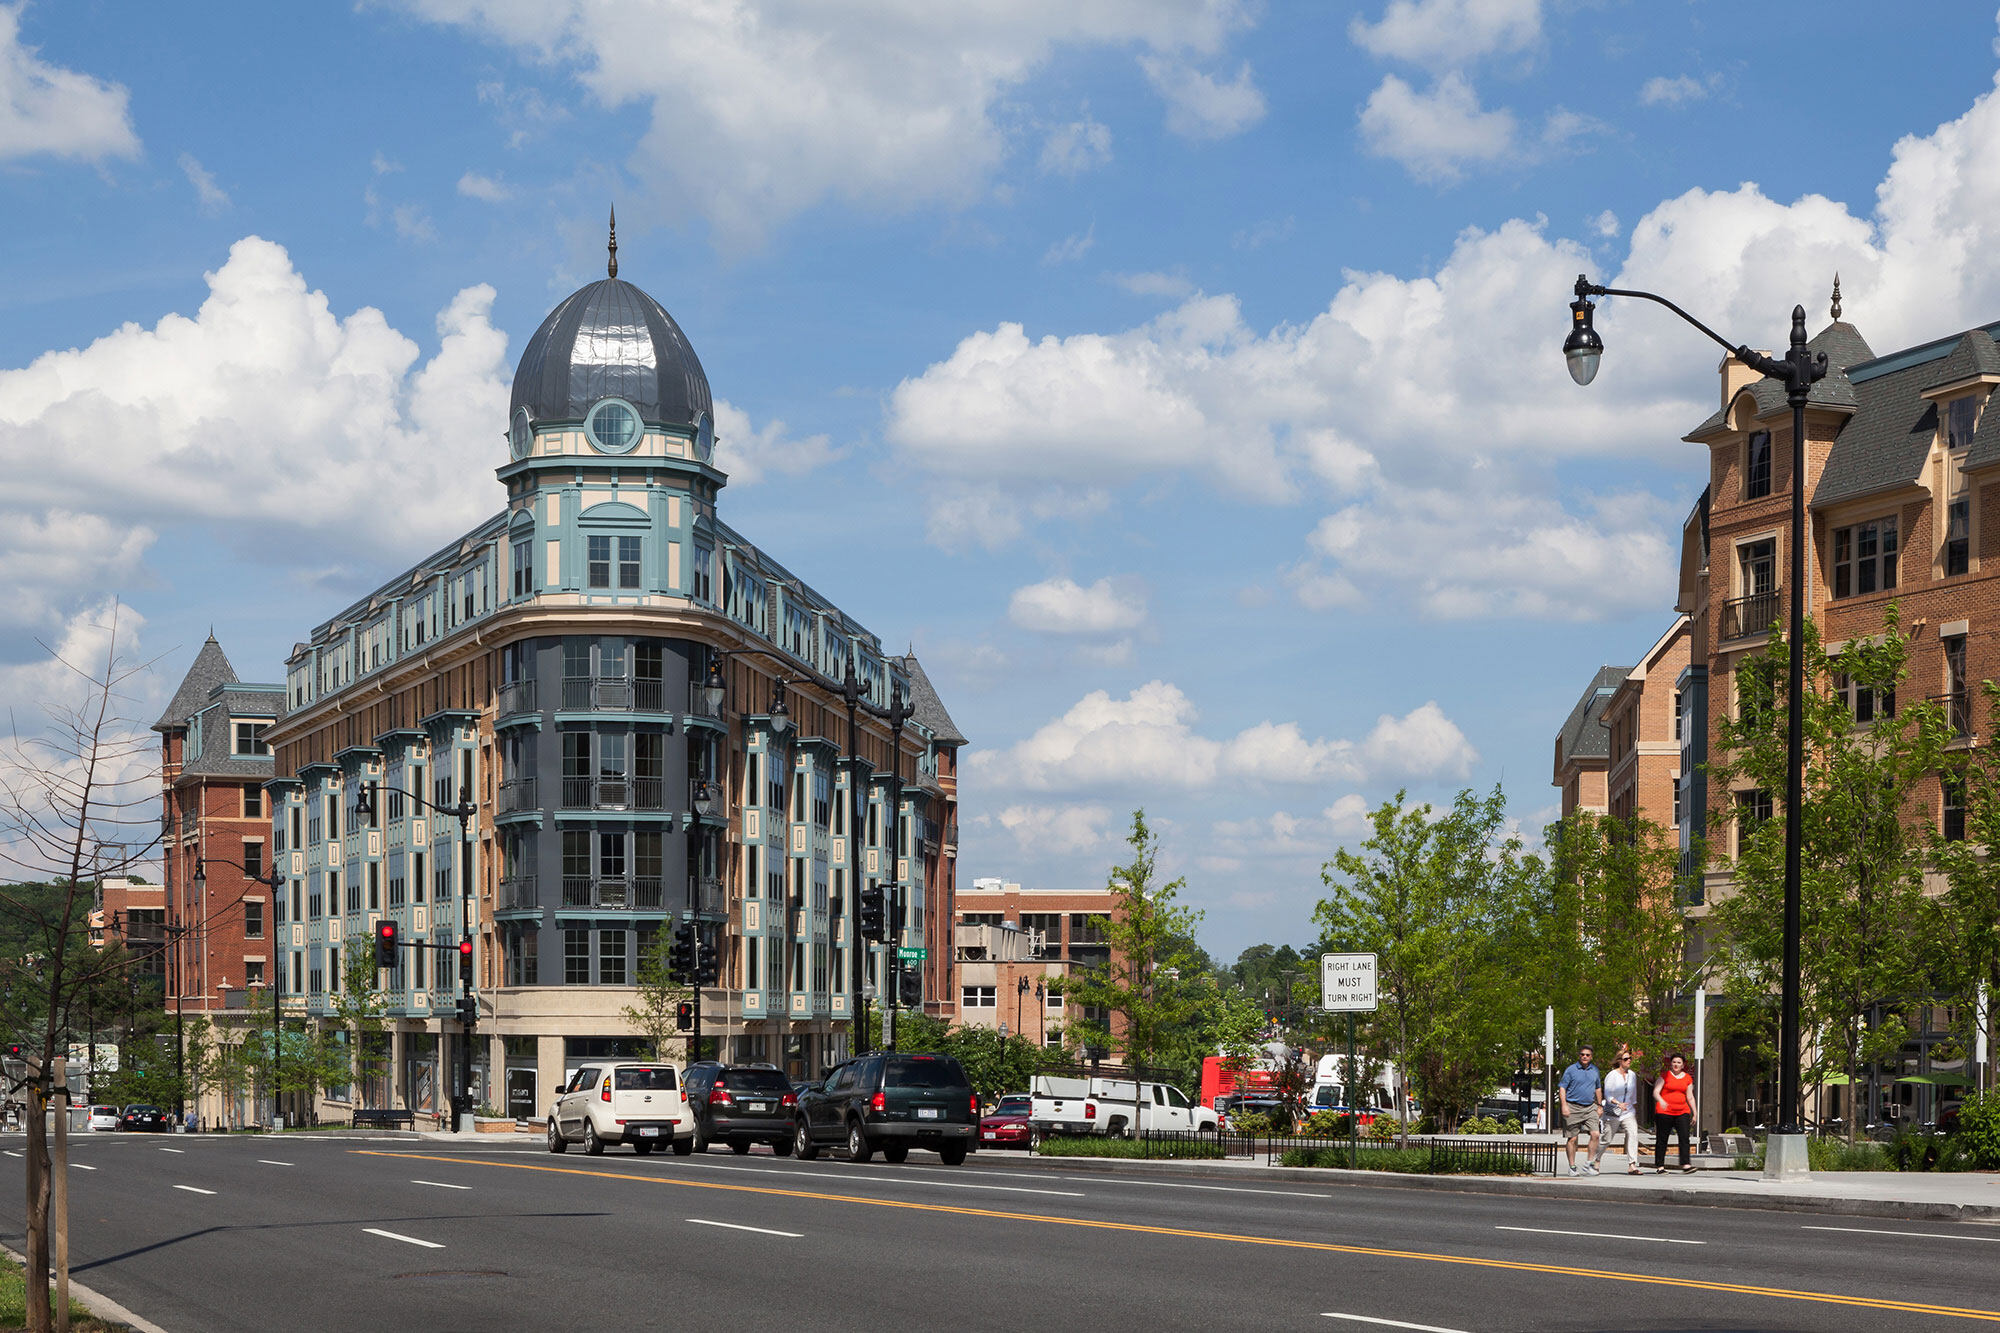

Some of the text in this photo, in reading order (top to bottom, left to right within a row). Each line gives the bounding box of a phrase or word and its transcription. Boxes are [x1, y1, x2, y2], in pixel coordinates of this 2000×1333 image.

[899, 949, 918, 958] Monroe
[1328, 962, 1372, 971] RIGHT LANE
[1338, 978, 1361, 987] MUST
[1328, 993, 1372, 1002] TURN RIGHT
